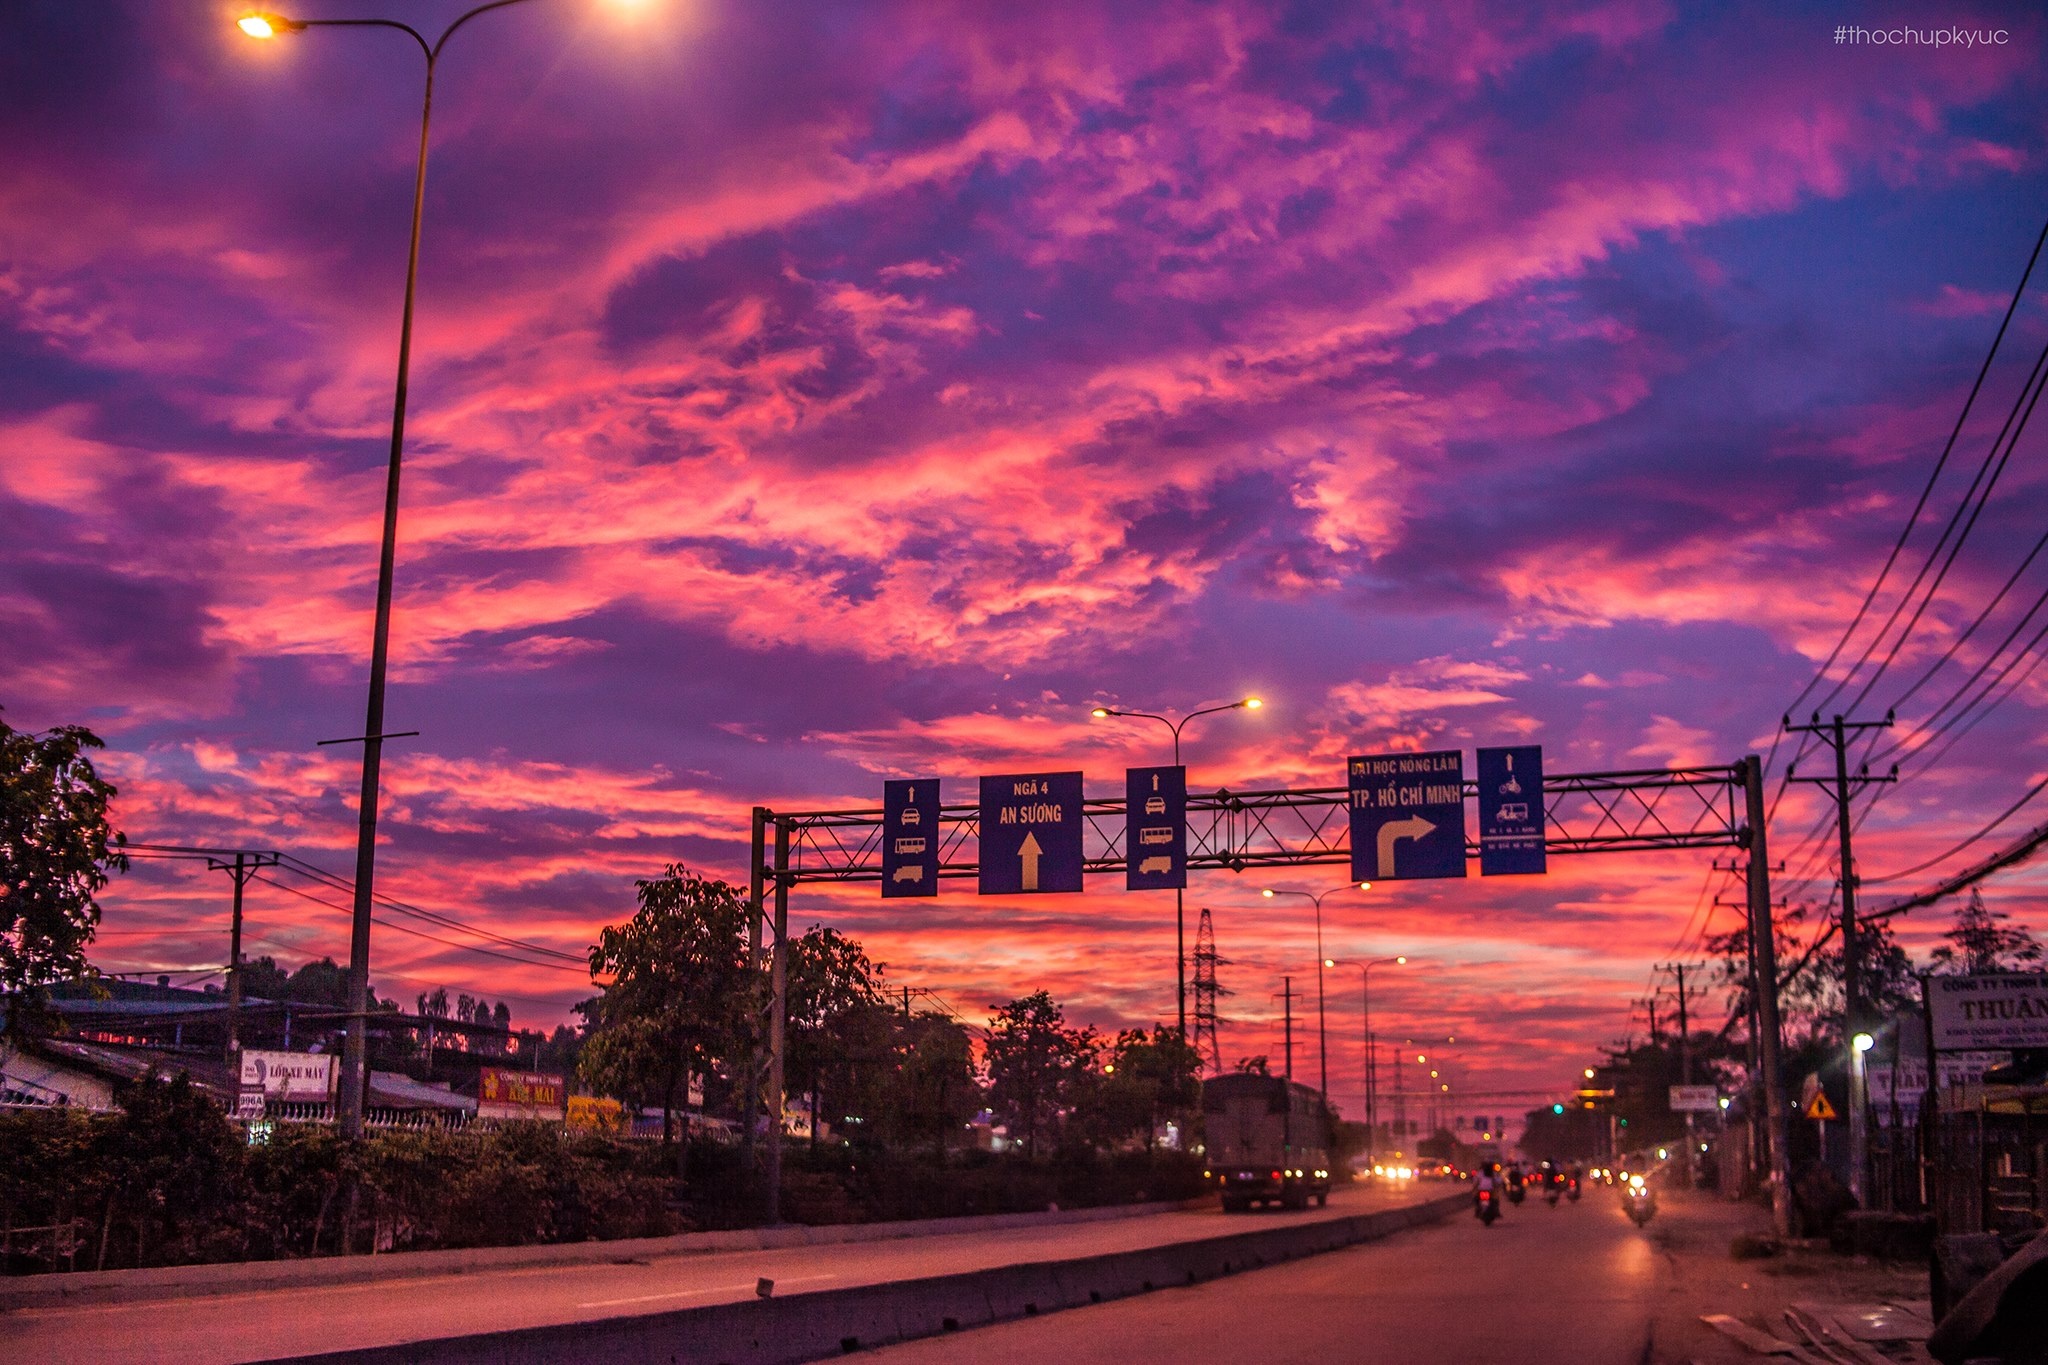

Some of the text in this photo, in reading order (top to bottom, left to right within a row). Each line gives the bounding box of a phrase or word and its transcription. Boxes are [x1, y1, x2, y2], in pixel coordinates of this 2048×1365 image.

[1373, 760, 1397, 777] HỌC
[1400, 755, 1431, 772] NÔNG
[1433, 754, 1458, 770] LÂM
[1014, 779, 1048, 795] NGÃ 4
[1351, 780, 1460, 809] TP. HỒ CHÍ MINH
[1000, 802, 1062, 824] AN SƯƠNG
[290, 1066, 304, 1079] XE
